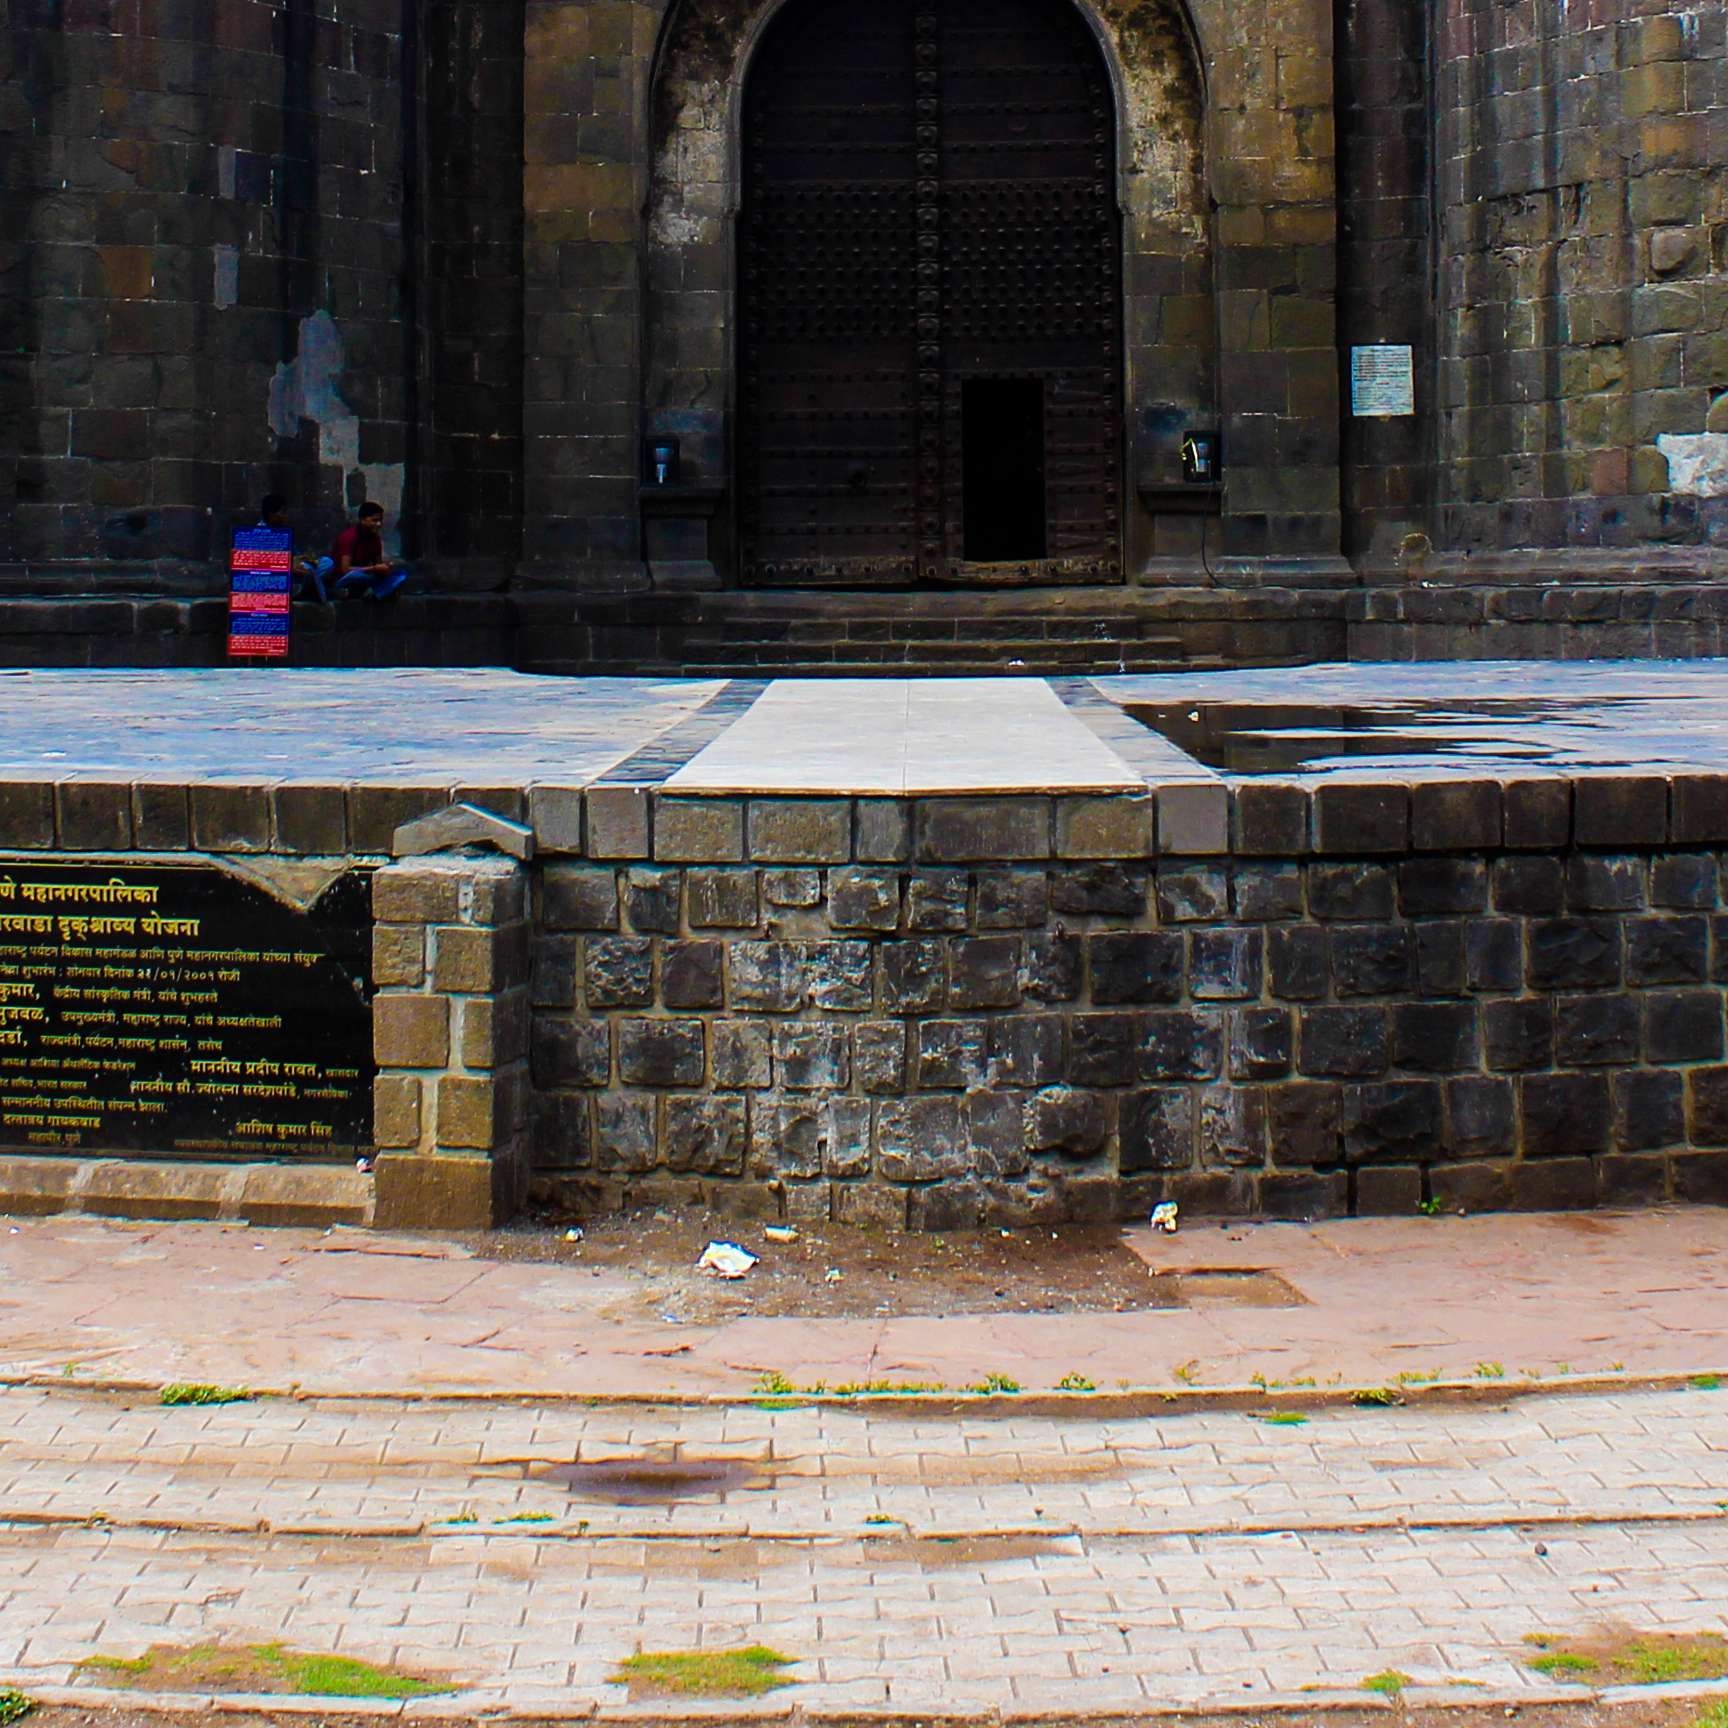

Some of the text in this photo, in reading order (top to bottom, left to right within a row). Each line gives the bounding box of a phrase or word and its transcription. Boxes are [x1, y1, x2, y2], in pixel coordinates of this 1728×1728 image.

[21, 877, 159, 903] महानगरपालिका
[141, 910, 200, 936] योजना
[191, 1057, 241, 1074] माननीय
[246, 1058, 280, 1077] प्रदीप
